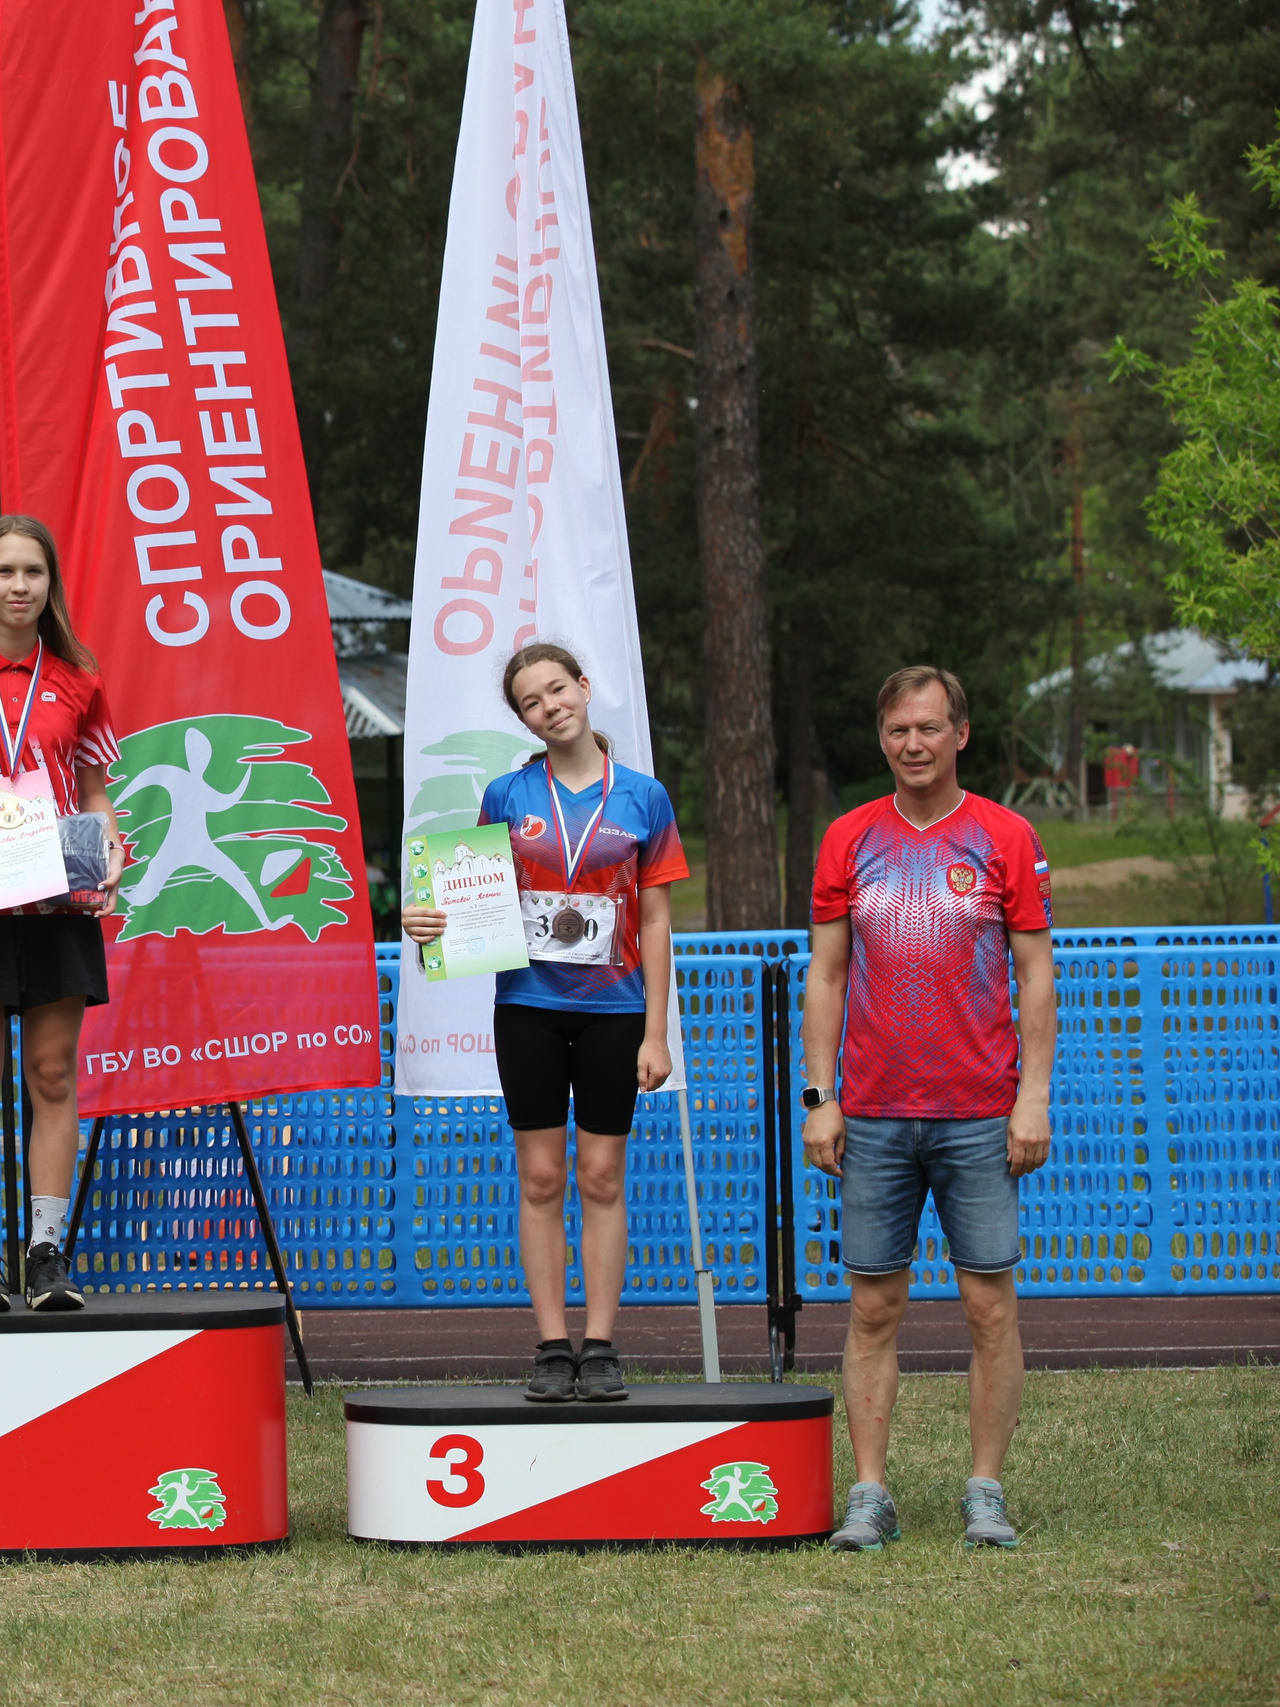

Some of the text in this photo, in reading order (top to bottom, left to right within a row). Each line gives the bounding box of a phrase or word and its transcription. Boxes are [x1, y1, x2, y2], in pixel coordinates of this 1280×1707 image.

[442, 872, 505, 893] ДИПЛОМ
[535, 915, 598, 941] 30
[86, 1024, 372, 1075] ГБУ ВО «СШОР по СО»
[425, 1433, 486, 1508] 3
